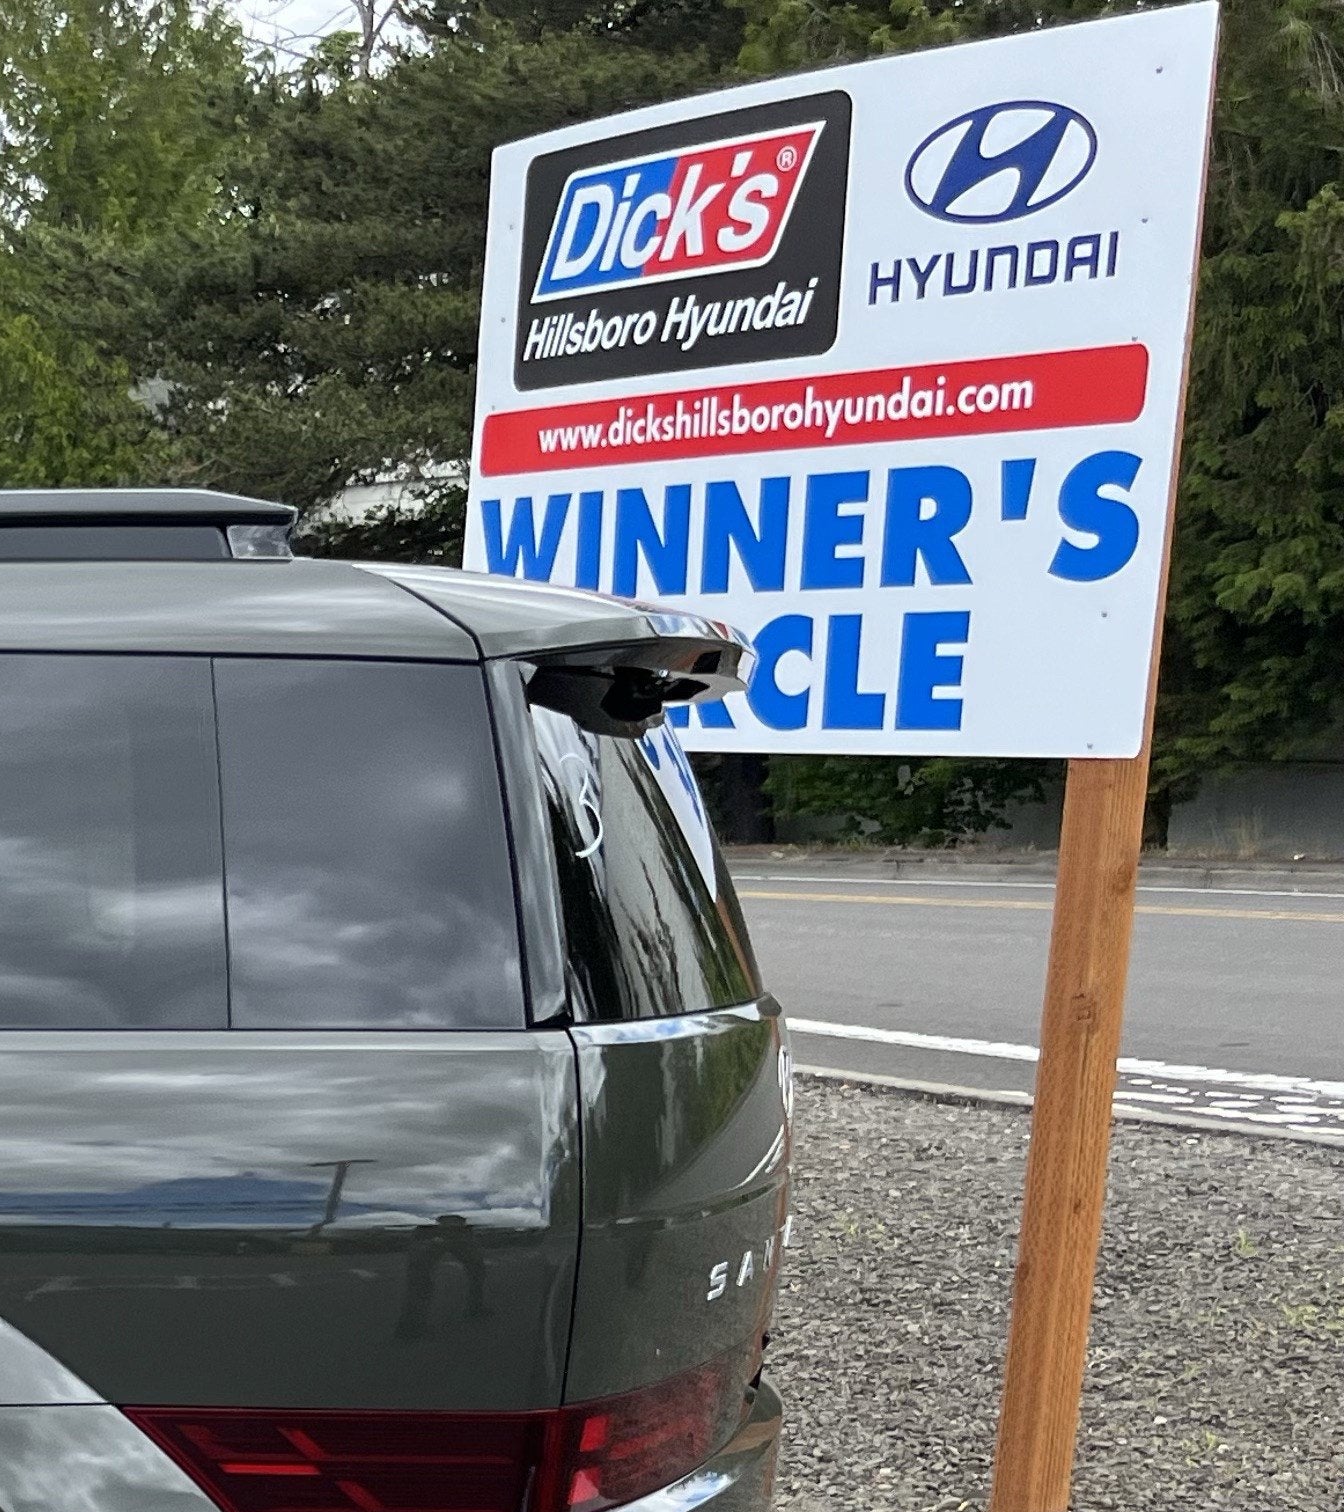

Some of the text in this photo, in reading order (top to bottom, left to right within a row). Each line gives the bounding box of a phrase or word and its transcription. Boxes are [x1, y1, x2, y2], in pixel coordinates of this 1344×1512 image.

[868, 231, 1119, 305] HYUNDAI
[523, 277, 819, 362] Hillsboro Hyundai
[538, 376, 1034, 452] www.dickshillsborohyundai.com
[480, 450, 1143, 598] WINNER'S
